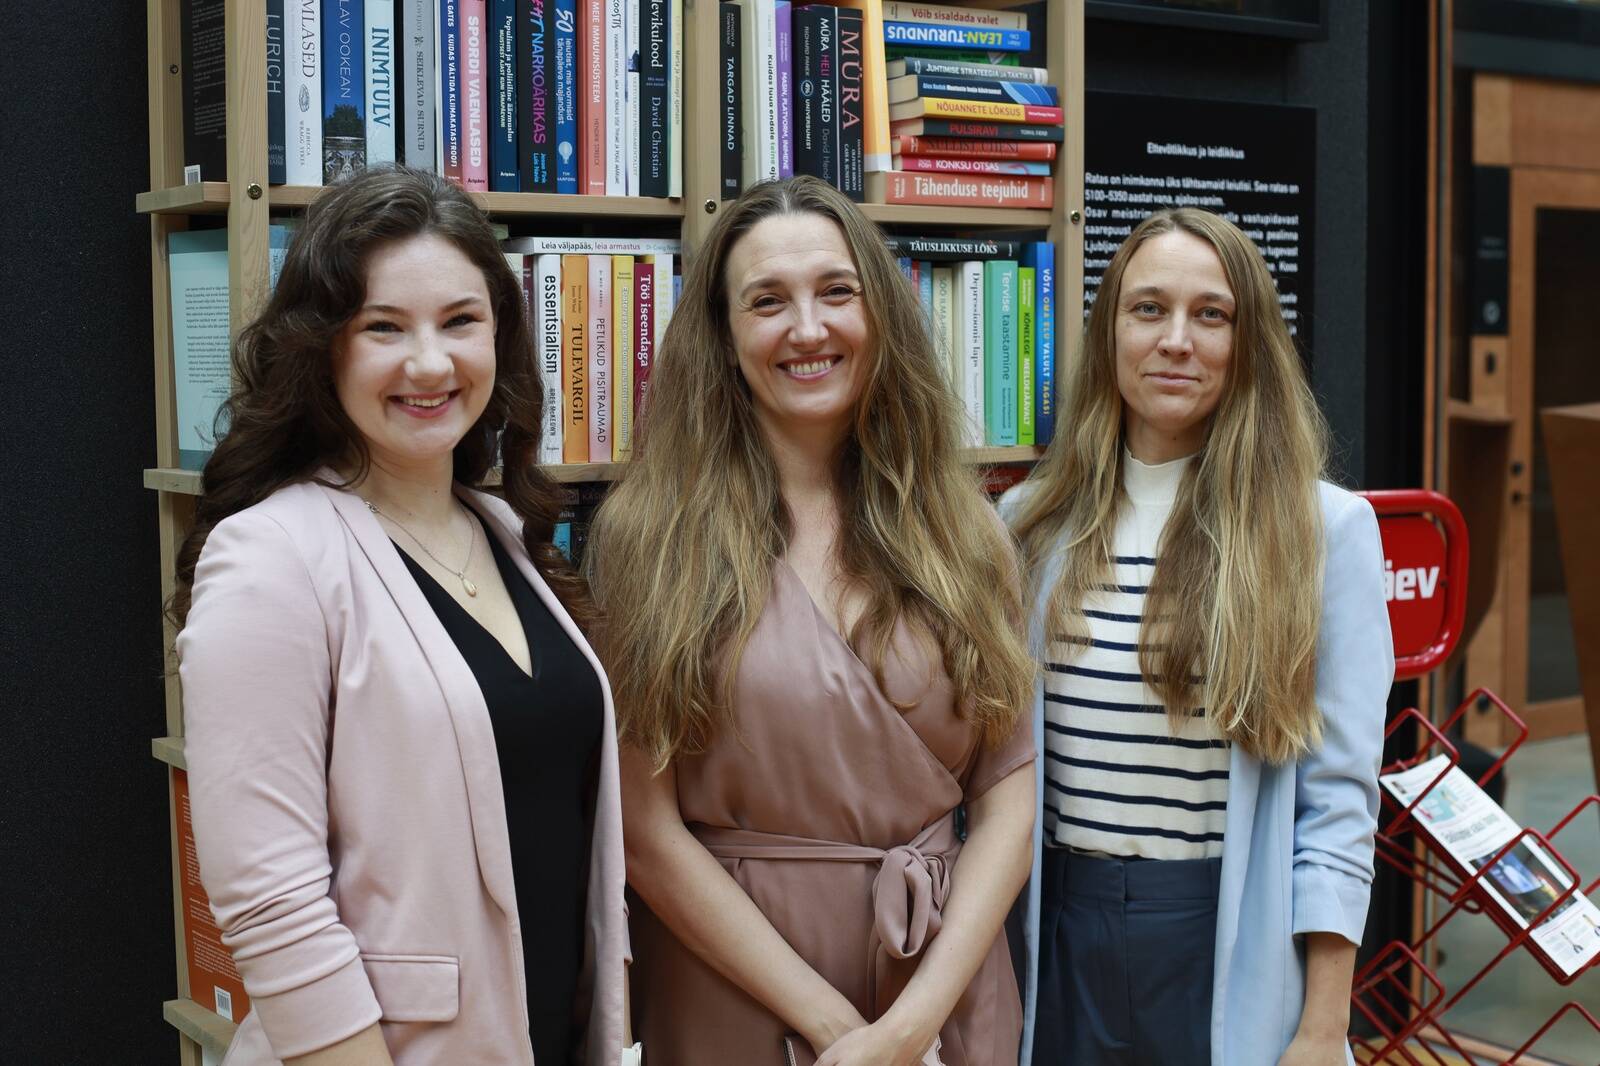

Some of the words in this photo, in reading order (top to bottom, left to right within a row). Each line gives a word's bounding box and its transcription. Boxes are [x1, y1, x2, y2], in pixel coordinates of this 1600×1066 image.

[447, 5, 455, 27] GATES
[556, 8, 574, 33] 50
[592, 1, 600, 23] MEIE
[912, 8, 933, 19] Võib
[933, 11, 976, 23] sisaldada
[977, 14, 999, 26] valet
[448, 33, 456, 61] KUIDAS
[467, 15, 480, 74] SPORDI
[505, 15, 513, 52] Populism
[820, 17, 831, 51] MÜRA
[887, 25, 1003, 46] LEAN-TURUNDUS
[266, 14, 281, 94] LURICH
[339, 33, 351, 98] OOKEAN
[505, 53, 513, 61] ja
[556, 37, 565, 80] tänapäeva
[564, 38, 573, 68] leiutist,
[592, 25, 602, 103] IMMUUNSÜSTEEM
[767, 54, 775, 85] Kuidas
[820, 55, 830, 76] HELI
[371, 27, 391, 128] INIMTULV
[416, 50, 425, 107] SEIKLEVAD
[448, 62, 457, 92] VÄLTIDA
[532, 33, 547, 144] NARKOÄRIKAS
[565, 70, 573, 85] mis
[727, 57, 735, 104] TARGAD
[841, 29, 863, 130] MÜRA
[926, 63, 960, 75] JUHTIMISE
[960, 66, 1000, 78] STRATEEGIA
[1006, 70, 1033, 80] TAKTIKA
[556, 81, 566, 125] majandust
[565, 86, 574, 121] vormisid
[650, 97, 662, 128] David
[821, 80, 832, 122] HÄÄLED
[936, 102, 988, 116] NÕUANNETE
[417, 110, 425, 151] SURNUD
[449, 93, 458, 167] KLIIMAKATASTROOFI
[468, 78, 482, 168] VAENLASED
[727, 107, 735, 150] LINNAD
[949, 123, 998, 137] PULSIRAVI
[650, 130, 662, 178] Christian
[935, 159, 971, 170] KONKSU
[972, 161, 1000, 171] OTSAS
[1147, 142, 1198, 157] Ettevõtlikkus
[1198, 146, 1206, 159] ja
[1207, 146, 1245, 159] leidlikkus
[914, 177, 977, 198] Tähenduse
[981, 181, 1029, 203] teejuhid
[1085, 172, 1109, 185] Ratas
[1110, 175, 1121, 185] on
[1121, 174, 1165, 188] inimkonna
[1166, 176, 1181, 189] üks
[1181, 177, 1225, 190] tähtsamaid
[1253, 180, 1269, 193] See
[1269, 182, 1288, 194] ratas
[1289, 184, 1299, 194] on
[1085, 206, 1108, 219] Osav
[541, 241, 557, 250] Leia
[557, 241, 594, 252] väljapääs,
[594, 241, 608, 250] leia
[608, 242, 641, 251] armastus
[909, 240, 974, 255] TÄIUSLIKKUSE
[974, 242, 998, 255] LÕKS
[1085, 225, 1132, 238] saarepuust
[640, 274, 652, 300] Töö
[1002, 271, 1013, 313] Tervise
[1043, 268, 1052, 294] VÕTA
[544, 275, 560, 374] essentsialism
[596, 318, 606, 366] PETLIKUD
[637, 303, 652, 367] iseendaga
[1023, 312, 1033, 356] KÕNELEGE
[970, 346, 981, 367] laps
[1002, 314, 1012, 380] taastamine
[1043, 342, 1051, 377] VALULT
[571, 323, 584, 426] TULEVARGIL
[1023, 358, 1033, 426] MEELDEJÄÄVALT
[596, 371, 606, 443] PISITRAUMAD
[1043, 380, 1051, 415] TAGASI
